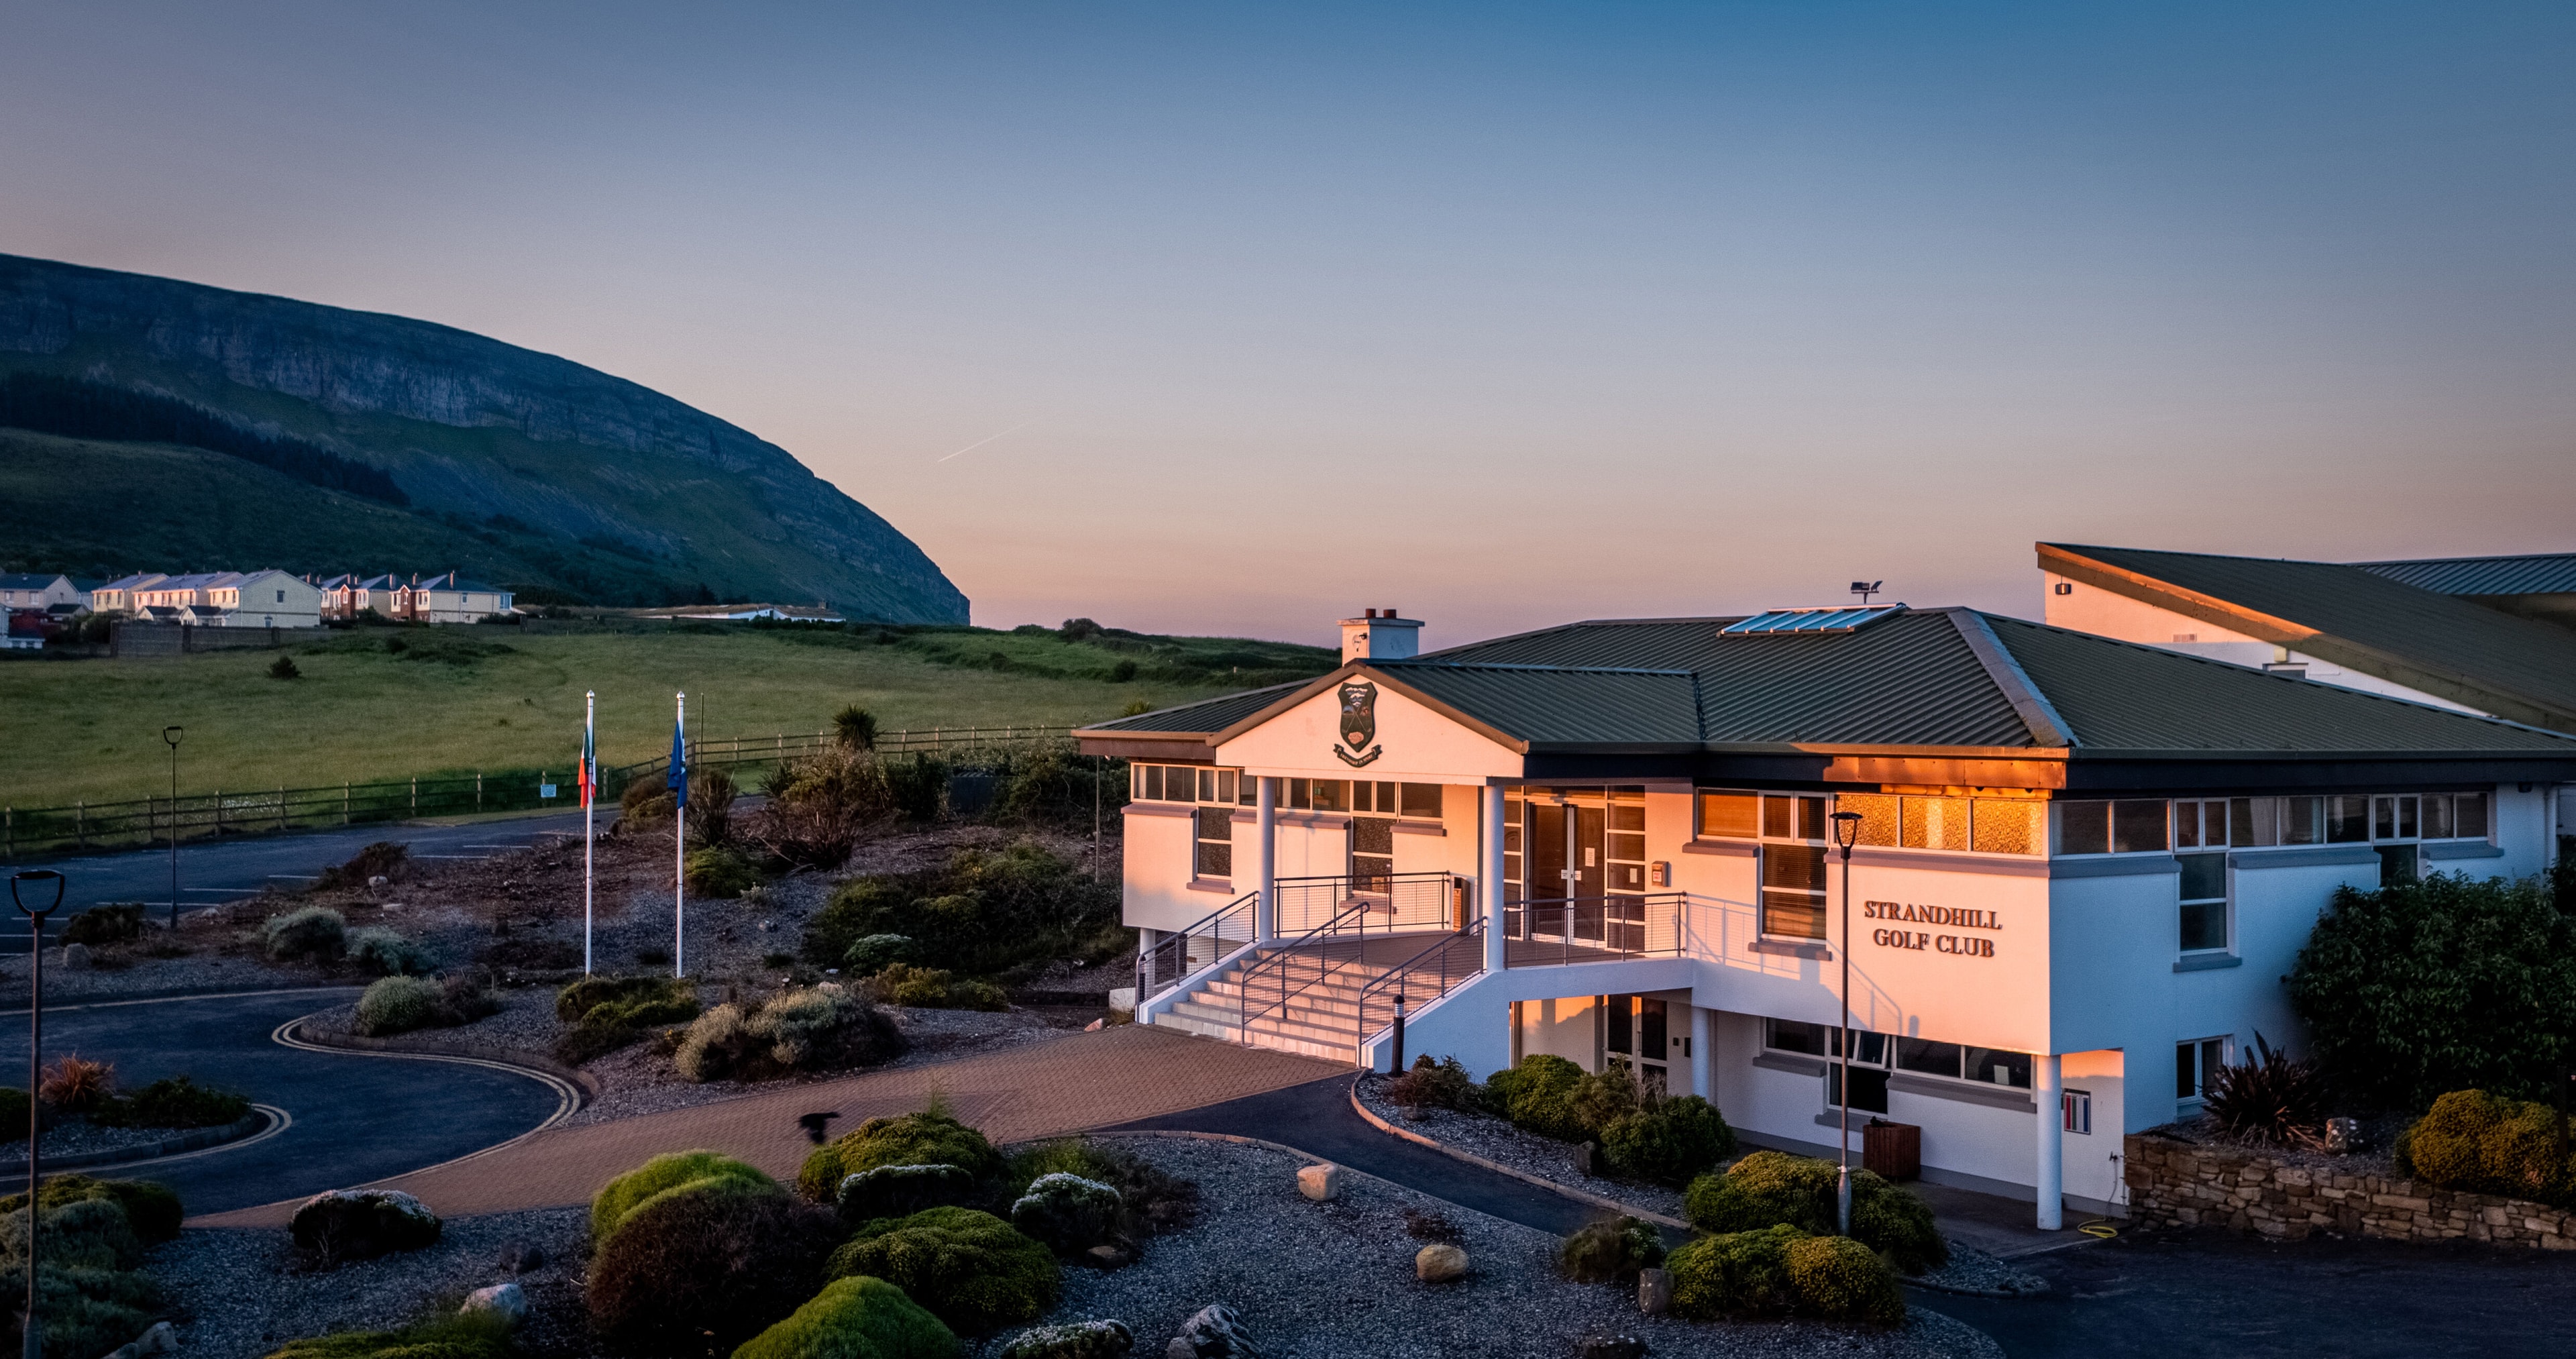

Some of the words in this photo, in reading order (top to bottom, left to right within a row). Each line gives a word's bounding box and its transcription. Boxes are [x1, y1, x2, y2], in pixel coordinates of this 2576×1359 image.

[1864, 900, 2001, 930] STRANDHILL
[1872, 928, 1929, 950] GOLF
[1935, 934, 1994, 957] CLUB
